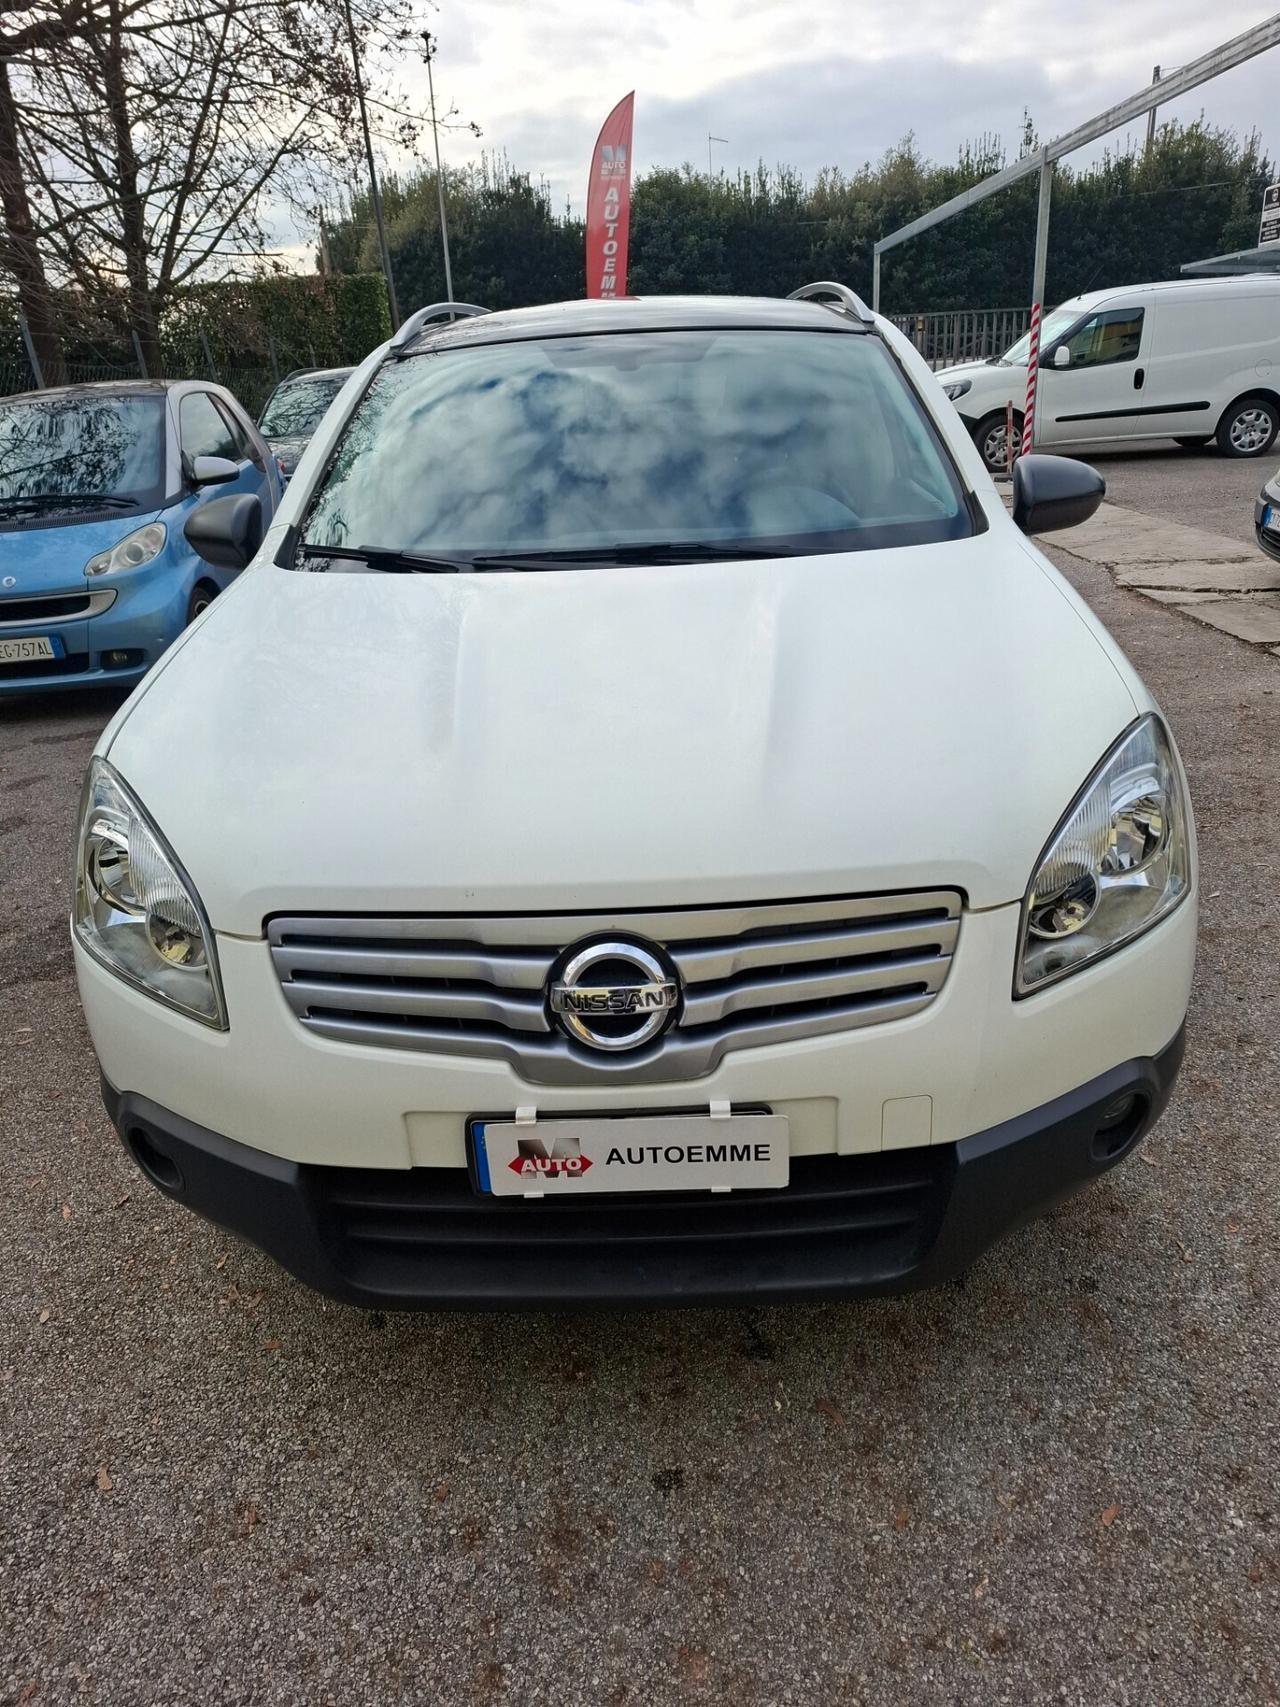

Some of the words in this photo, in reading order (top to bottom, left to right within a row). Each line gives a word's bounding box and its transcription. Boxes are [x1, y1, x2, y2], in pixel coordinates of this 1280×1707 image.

[601, 161, 626, 169] AUTO
[563, 990, 663, 1011] NISSAN
[605, 1143, 771, 1166] AUTOEMME
[520, 1157, 582, 1173] AUTO
